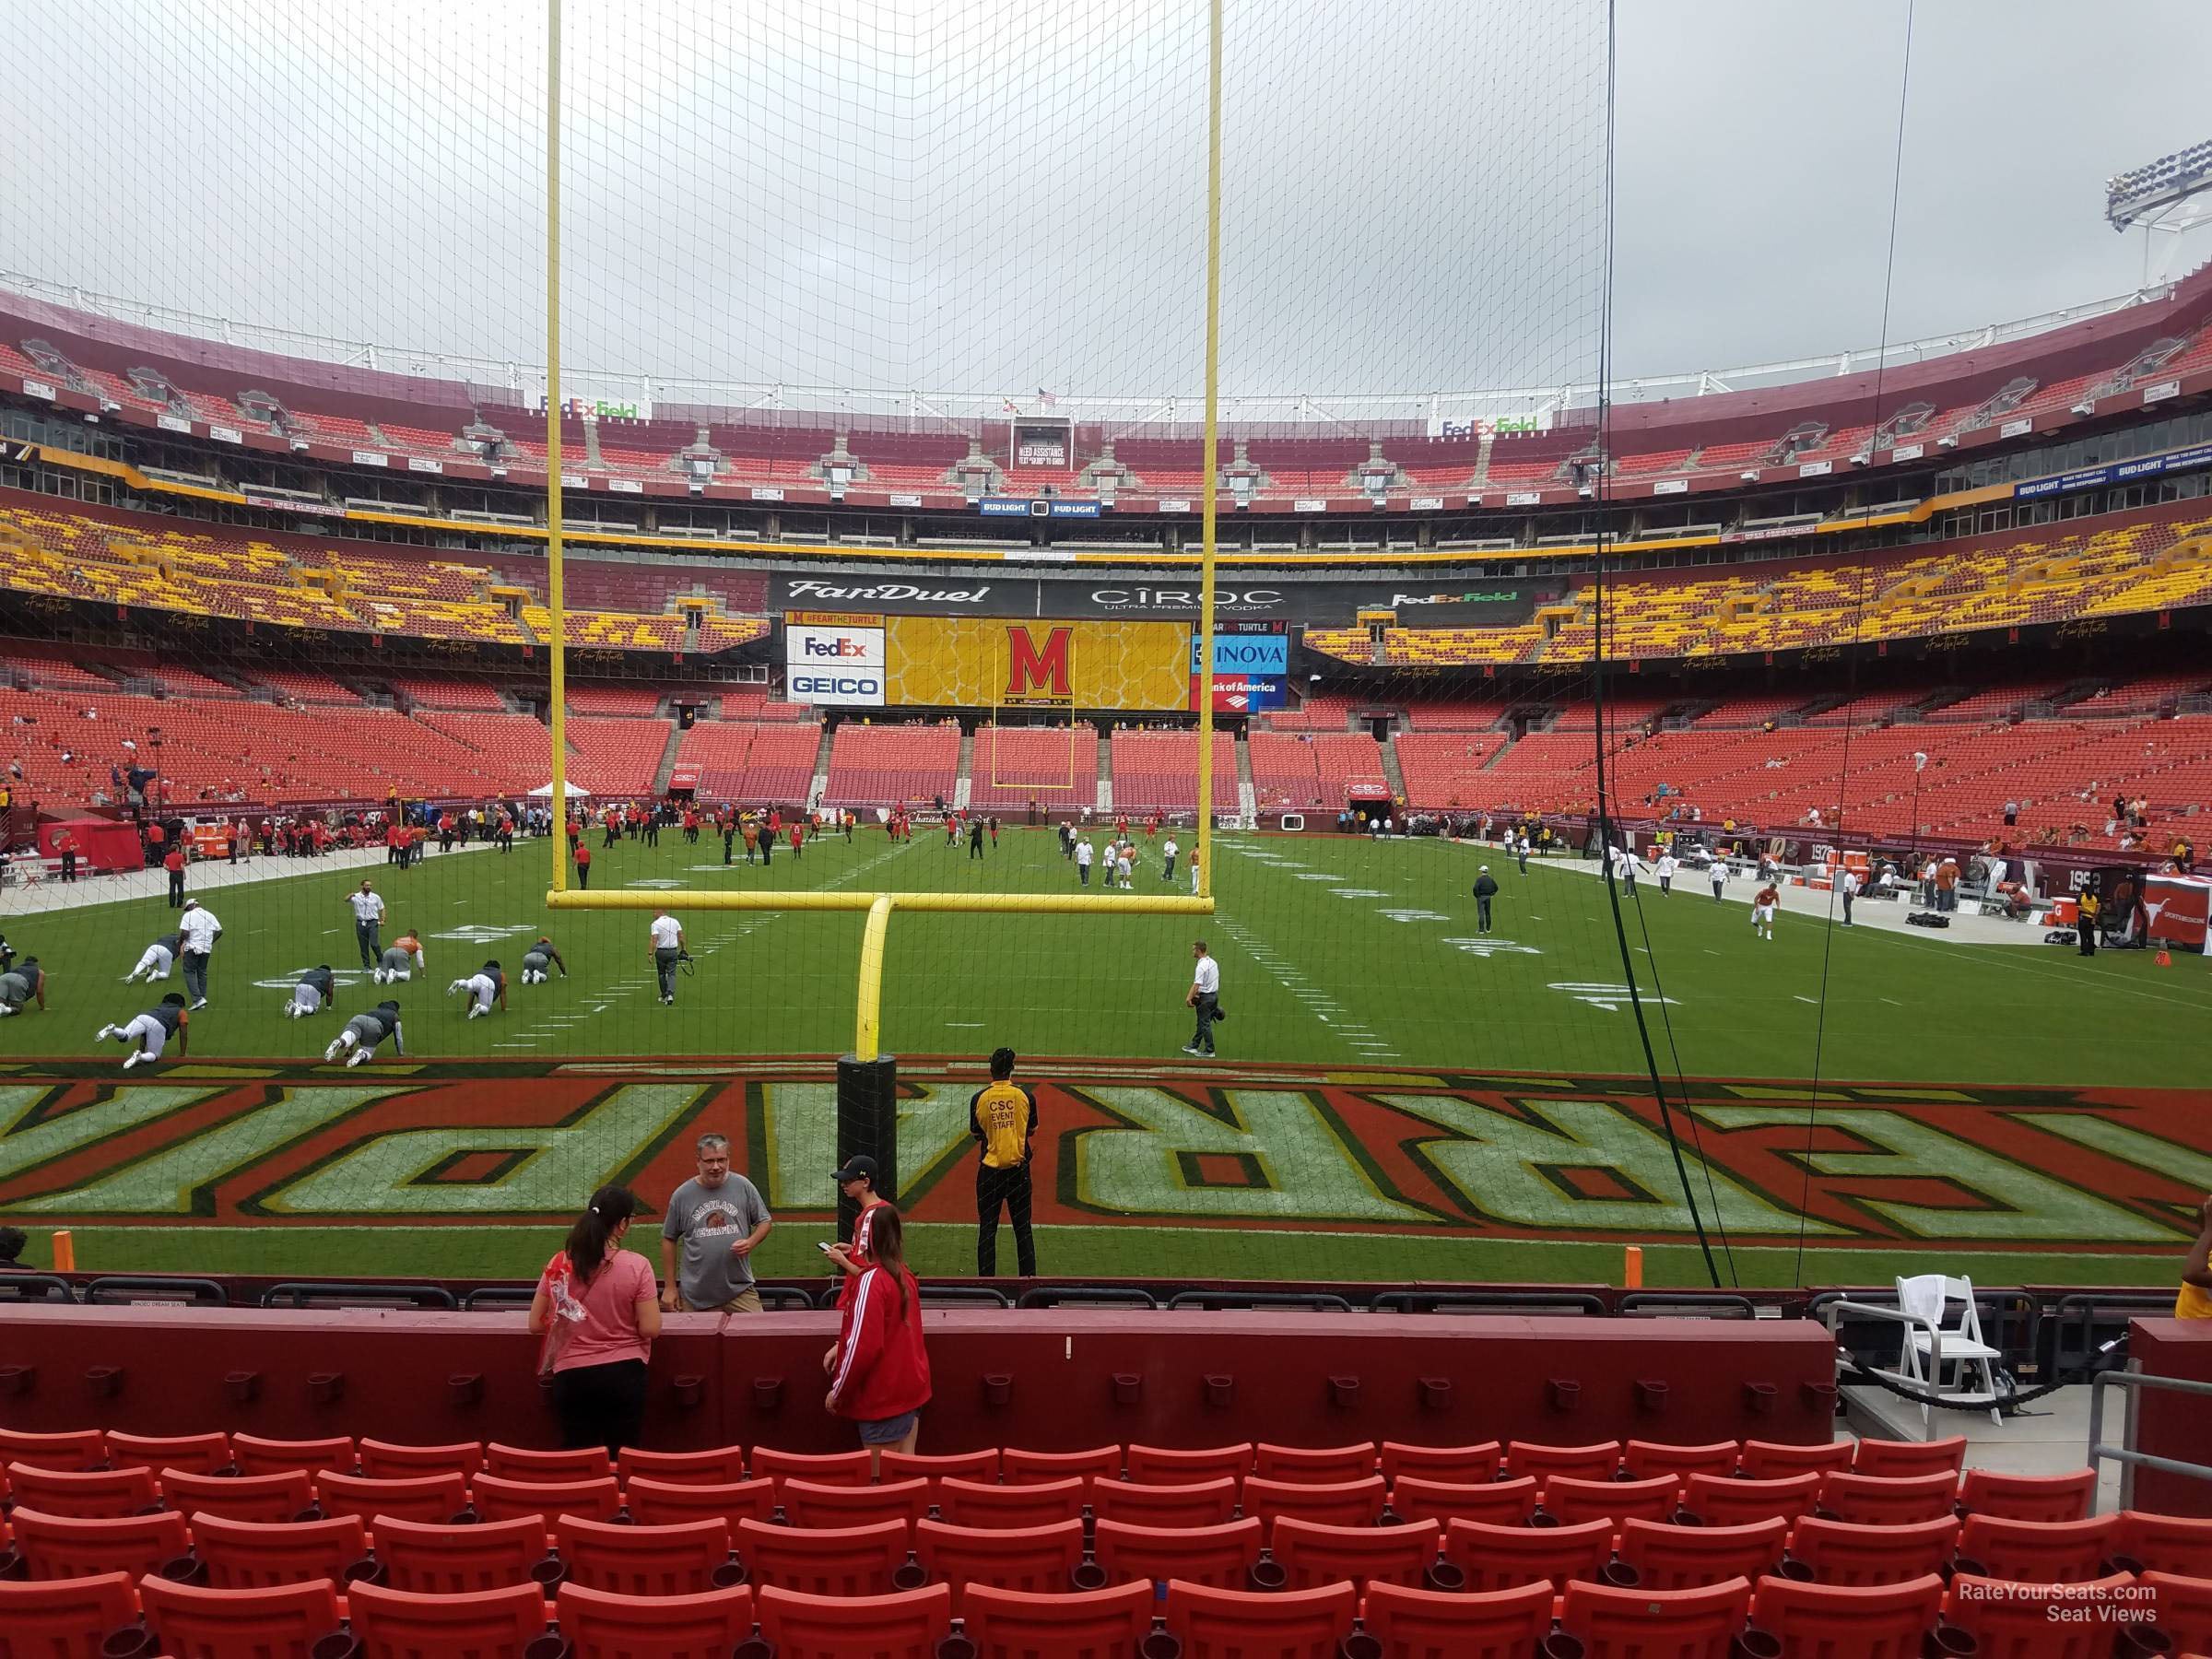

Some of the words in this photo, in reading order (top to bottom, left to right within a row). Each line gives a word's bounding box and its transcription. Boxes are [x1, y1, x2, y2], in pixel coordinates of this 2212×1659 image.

[540, 395, 637, 418] FdExField
[1442, 417, 1537, 435] FedExField
[1018, 446, 1033, 456] NEED
[1033, 447, 1065, 457] ASSISTANCE
[2119, 465, 2136, 477] BUD
[2137, 459, 2162, 473] LIGHT
[2019, 485, 2036, 496] BUD
[2036, 480, 2059, 493] LIGHT
[788, 581, 991, 602] FanDuel
[1392, 591, 1517, 606] FedExField
[806, 613, 878, 624] #FEARTHETURTLE
[805, 637, 866, 657] FedEx
[1217, 646, 1284, 663] INOVA
[1006, 627, 1073, 695] M
[793, 677, 878, 695] GEICO
[1235, 682, 1276, 692] America
[2054, 904, 2062, 916] G
[989, 1100, 1014, 1112] CSC
[991, 1112, 1014, 1122] EVENT
[993, 1121, 1015, 1130] STAFF
[691, 1200, 739, 1222] MARYLAND
